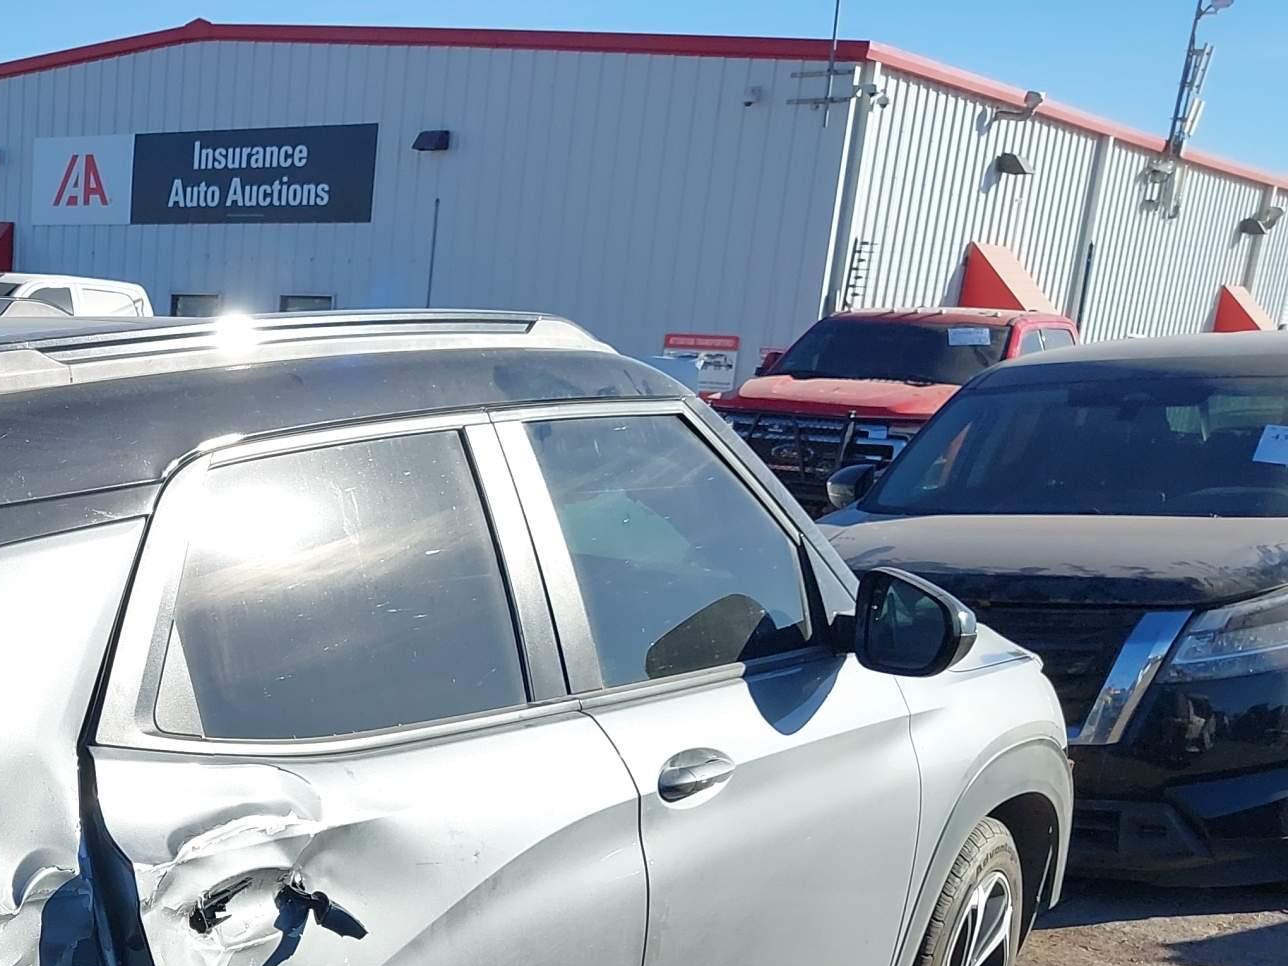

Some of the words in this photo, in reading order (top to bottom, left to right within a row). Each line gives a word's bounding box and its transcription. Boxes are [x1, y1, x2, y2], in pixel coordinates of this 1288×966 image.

[193, 140, 308, 170] Insurance
[168, 178, 220, 207] Auto
[226, 176, 329, 206] Auctions
